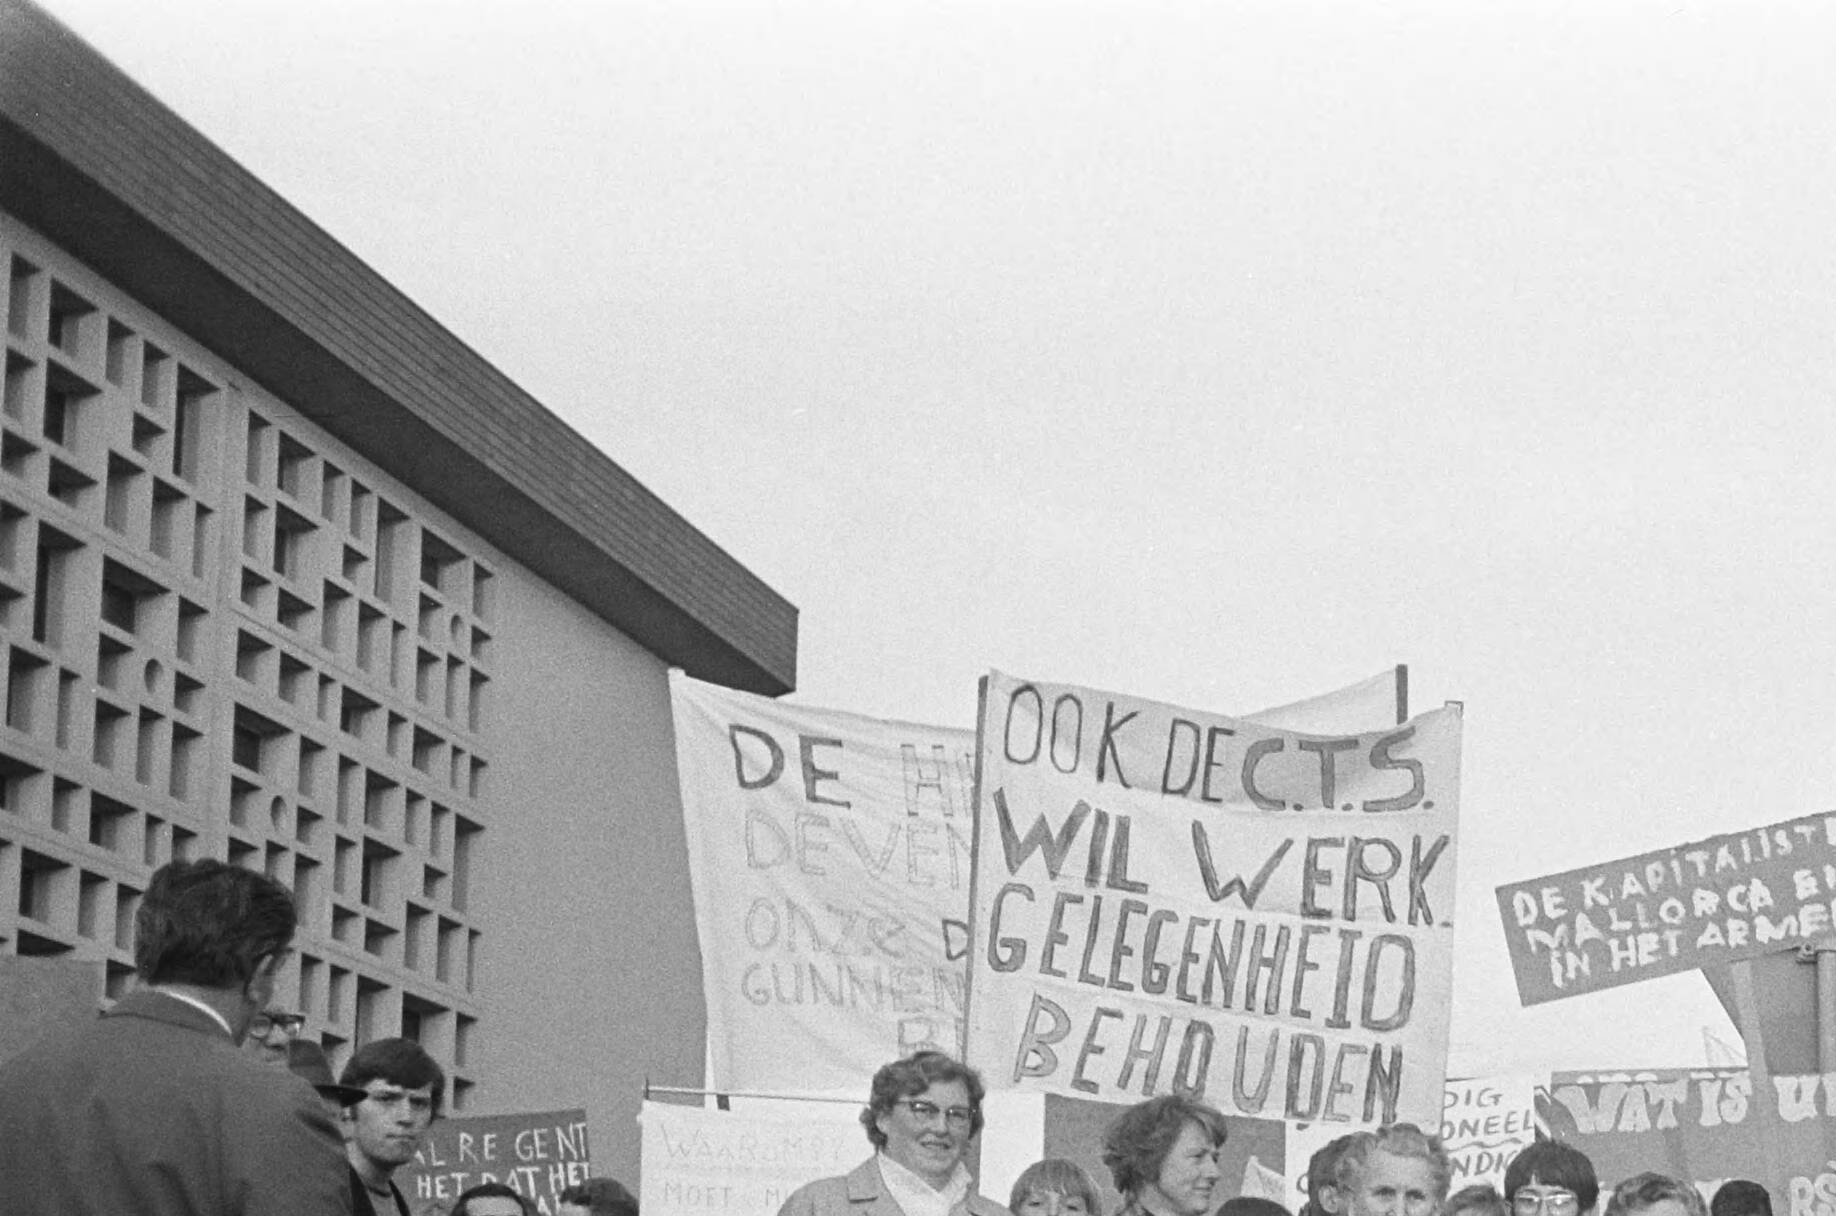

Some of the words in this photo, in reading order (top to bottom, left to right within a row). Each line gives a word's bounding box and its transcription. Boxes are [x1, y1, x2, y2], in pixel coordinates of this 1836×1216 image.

[729, 723, 851, 808] DE
[1004, 682, 1140, 789] OOK
[1160, 716, 1236, 803] DE
[993, 786, 1149, 895] WIL
[1512, 886, 1570, 928] DE
[1526, 877, 1775, 956] MALLORCA
[987, 881, 1417, 1033] GELEGENHEID
[1609, 927, 1683, 973] HET
[1013, 988, 1404, 1124] BEHOUDEN
[1551, 1082, 1689, 1133] WAT
[1699, 1077, 1754, 1127] IS
[417, 1172, 470, 1199] HET
